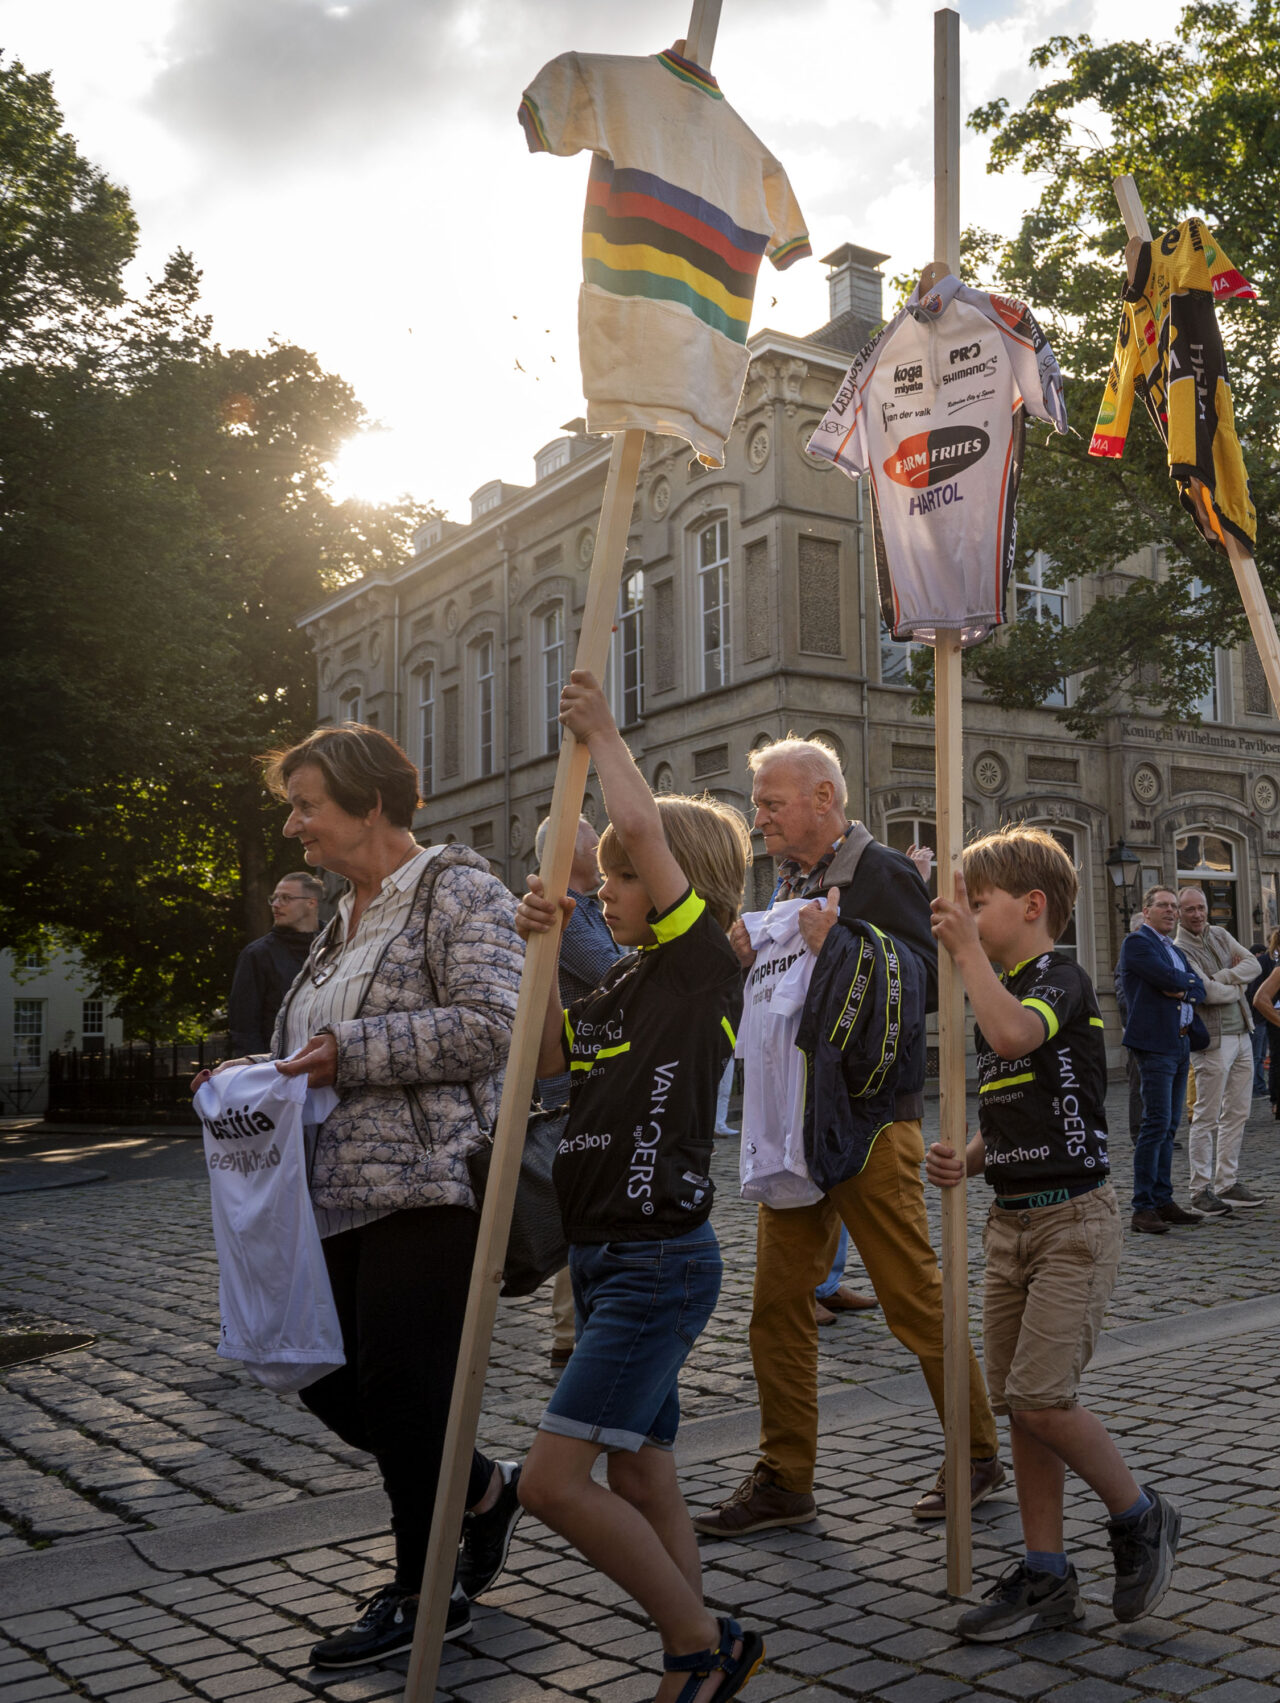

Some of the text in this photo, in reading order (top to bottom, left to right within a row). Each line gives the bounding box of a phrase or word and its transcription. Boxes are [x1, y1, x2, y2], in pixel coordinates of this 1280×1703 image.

[949, 342, 981, 364] PRO
[893, 364, 922, 383] koga
[942, 362, 986, 385] SHIMANO
[894, 382, 923, 395] miyata
[899, 410, 912, 419] der
[895, 438, 983, 475] FARM FRITES
[908, 482, 964, 517] HARTOL
[1175, 727, 1237, 749] Wilhelmina
[851, 974, 867, 1000] CRS
[889, 979, 900, 1005] CRS
[839, 1004, 857, 1029] JNS
[885, 1022, 899, 1046] JNS
[649, 1060, 680, 1115] VAN
[1051, 1096, 1060, 1116] agro
[1062, 1094, 1087, 1158] OERS
